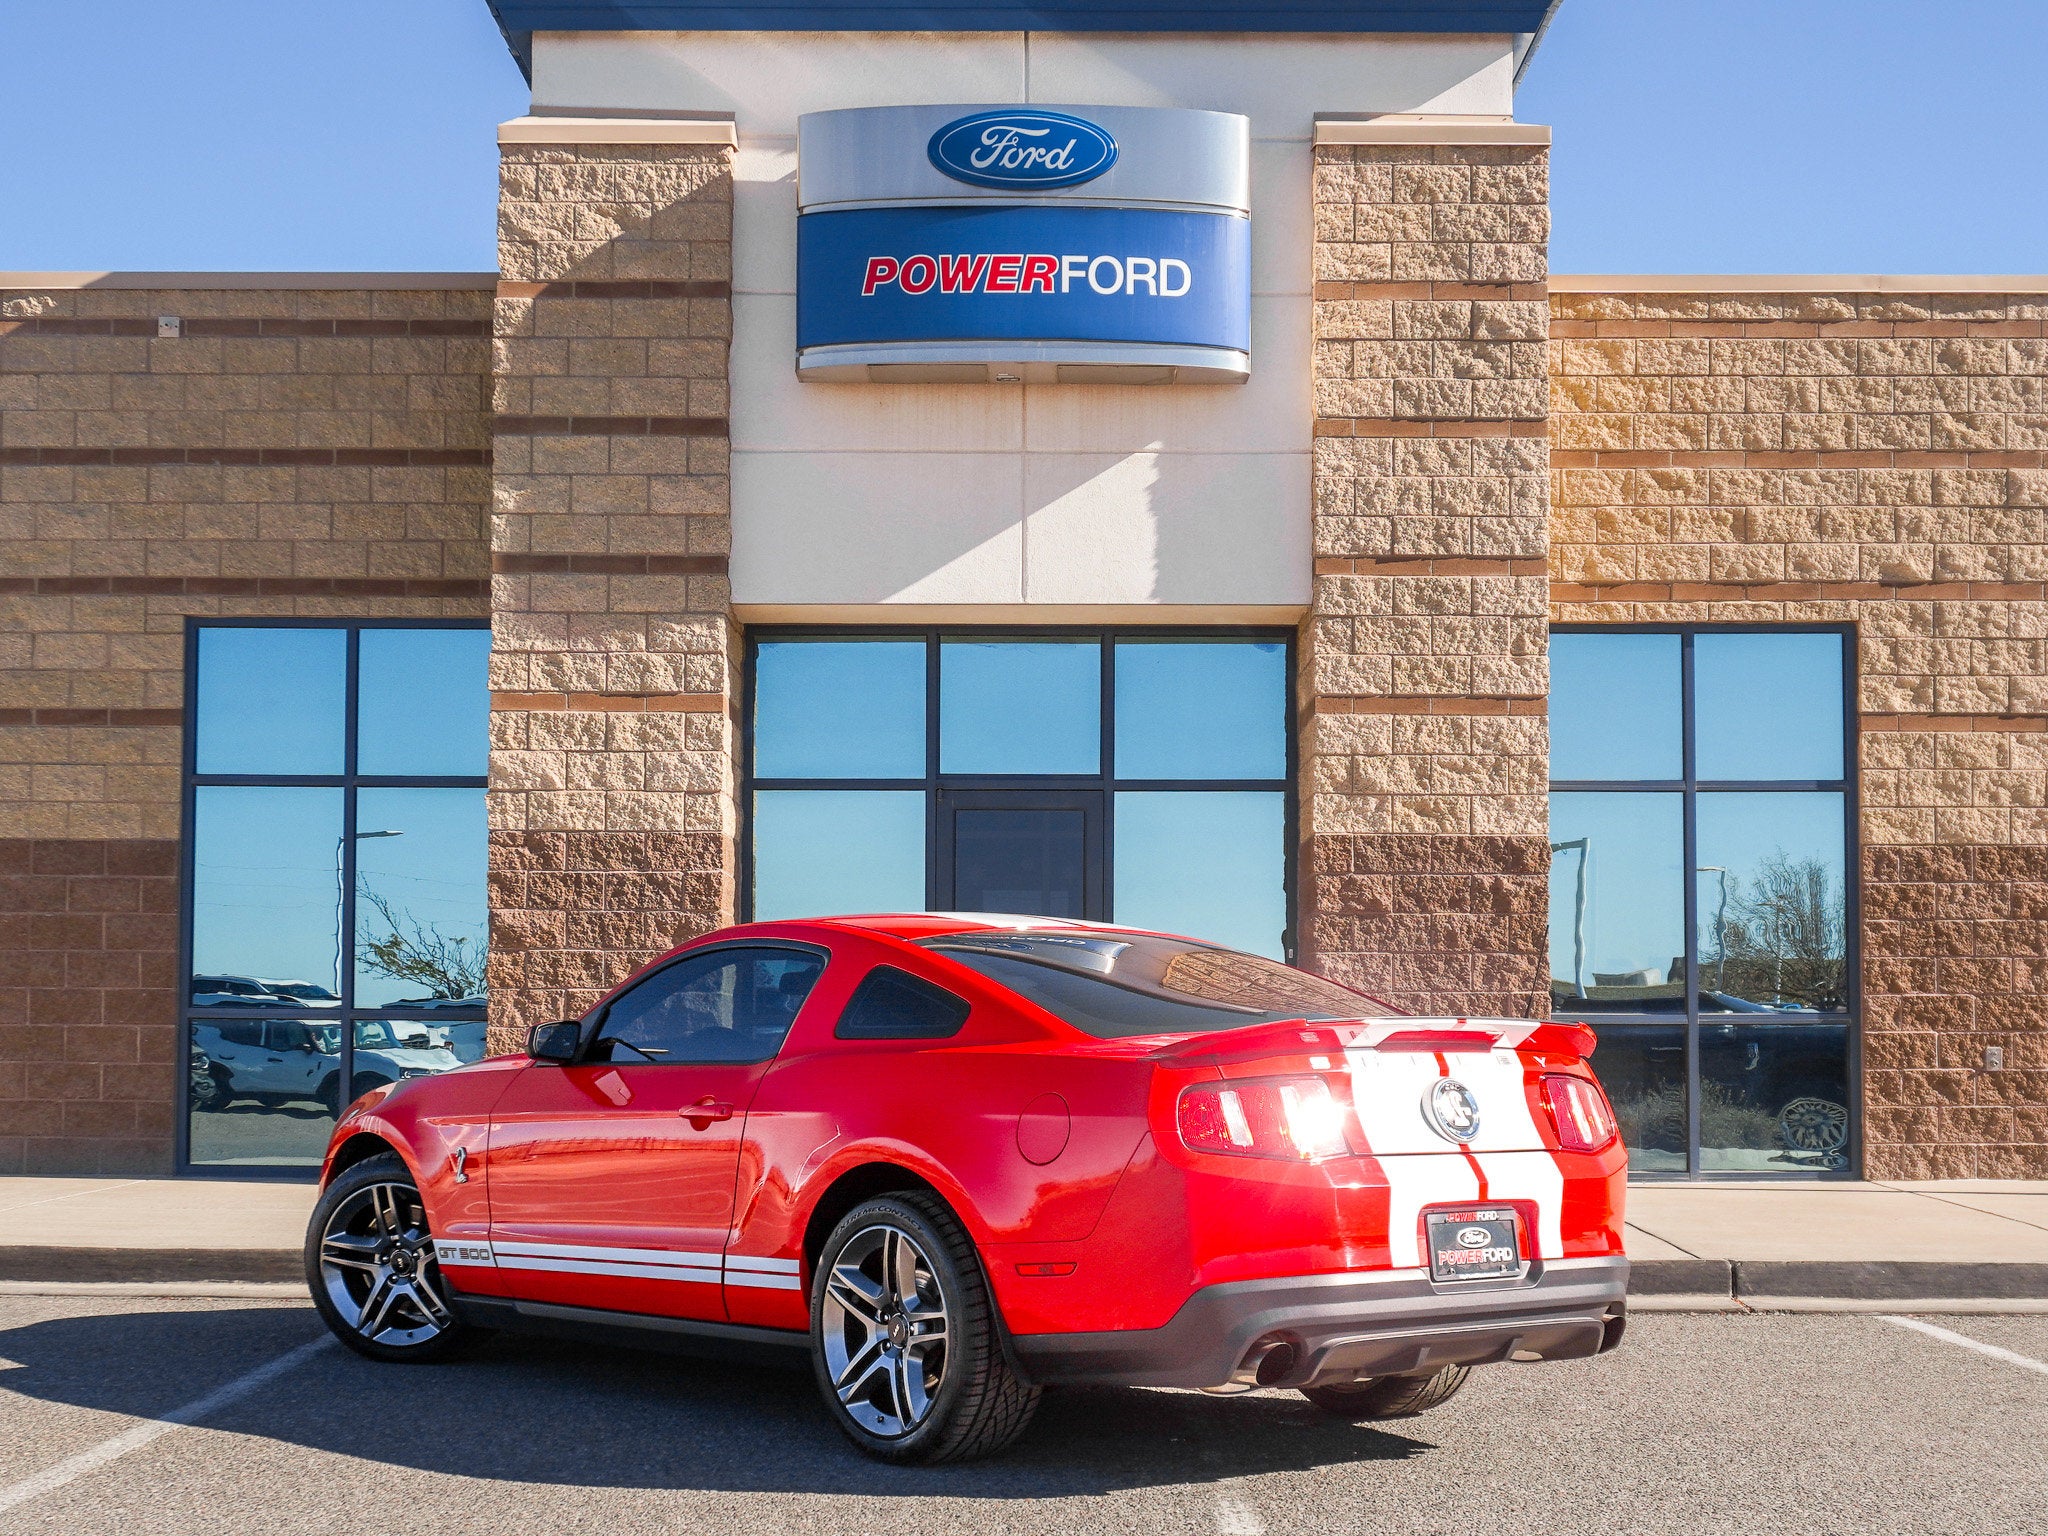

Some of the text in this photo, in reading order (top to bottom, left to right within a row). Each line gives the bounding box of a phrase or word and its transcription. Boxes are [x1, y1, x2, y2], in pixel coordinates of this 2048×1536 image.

[970, 125, 1078, 171] Ford
[861, 254, 1193, 298] POWERFORD
[438, 1246, 490, 1260] GT 500
[1437, 1246, 1514, 1266] POWERFORD
